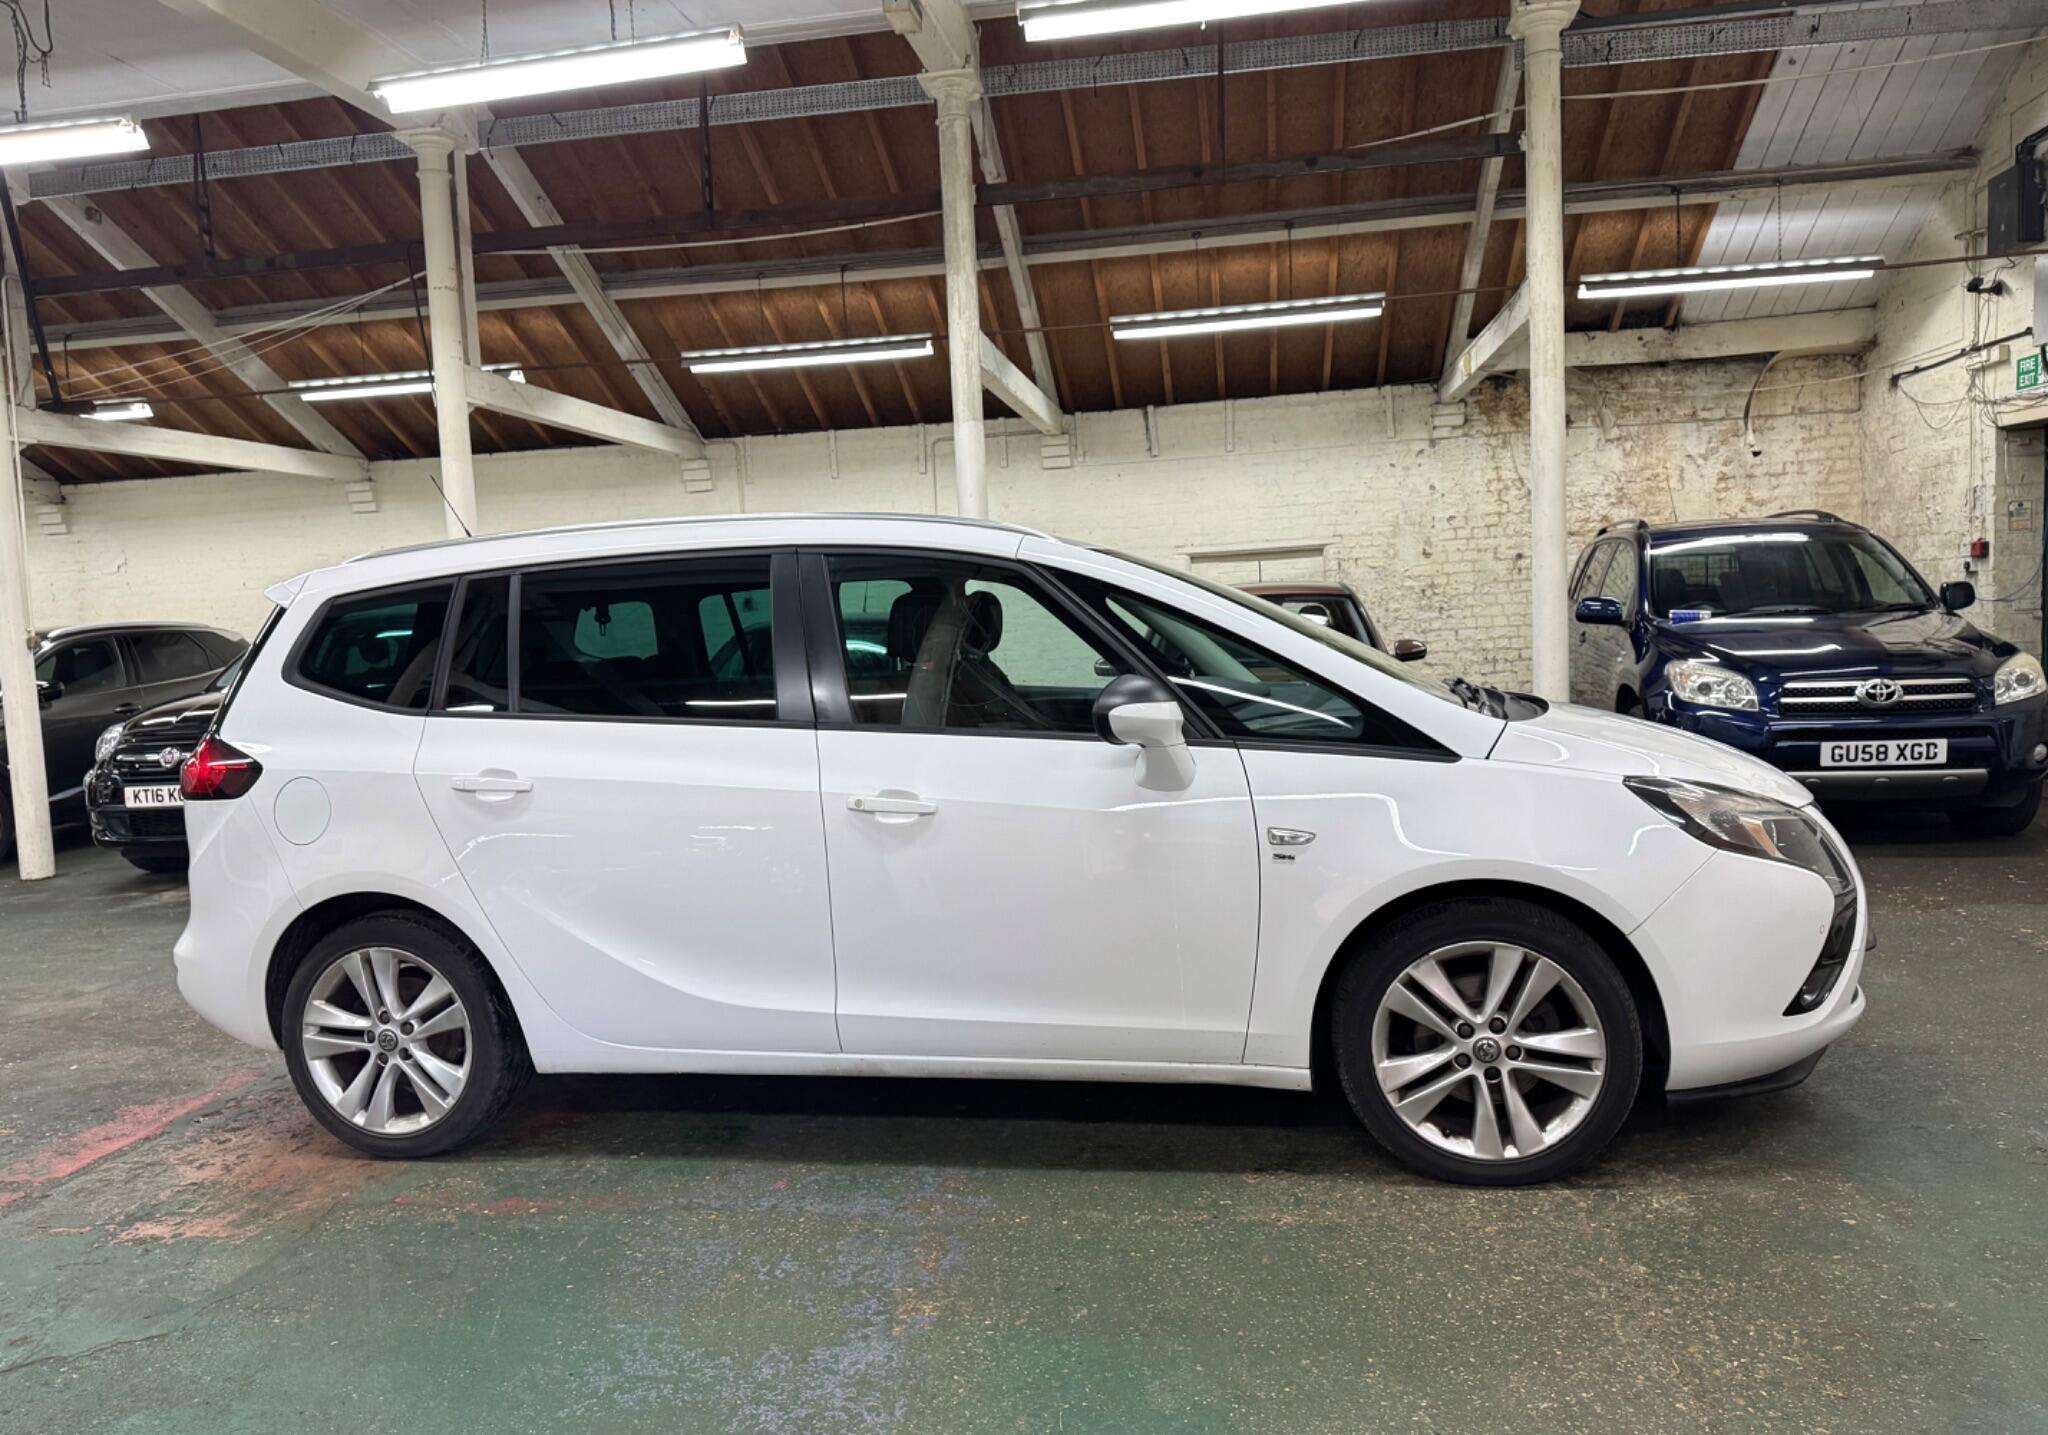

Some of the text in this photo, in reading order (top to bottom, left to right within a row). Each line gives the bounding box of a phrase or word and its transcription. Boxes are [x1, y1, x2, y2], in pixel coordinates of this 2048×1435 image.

[2020, 358, 2037, 372] FIRE
[2020, 373, 2036, 387] EXIT
[1831, 742, 1938, 763] GU58 XGD
[133, 788, 164, 804] KT16
